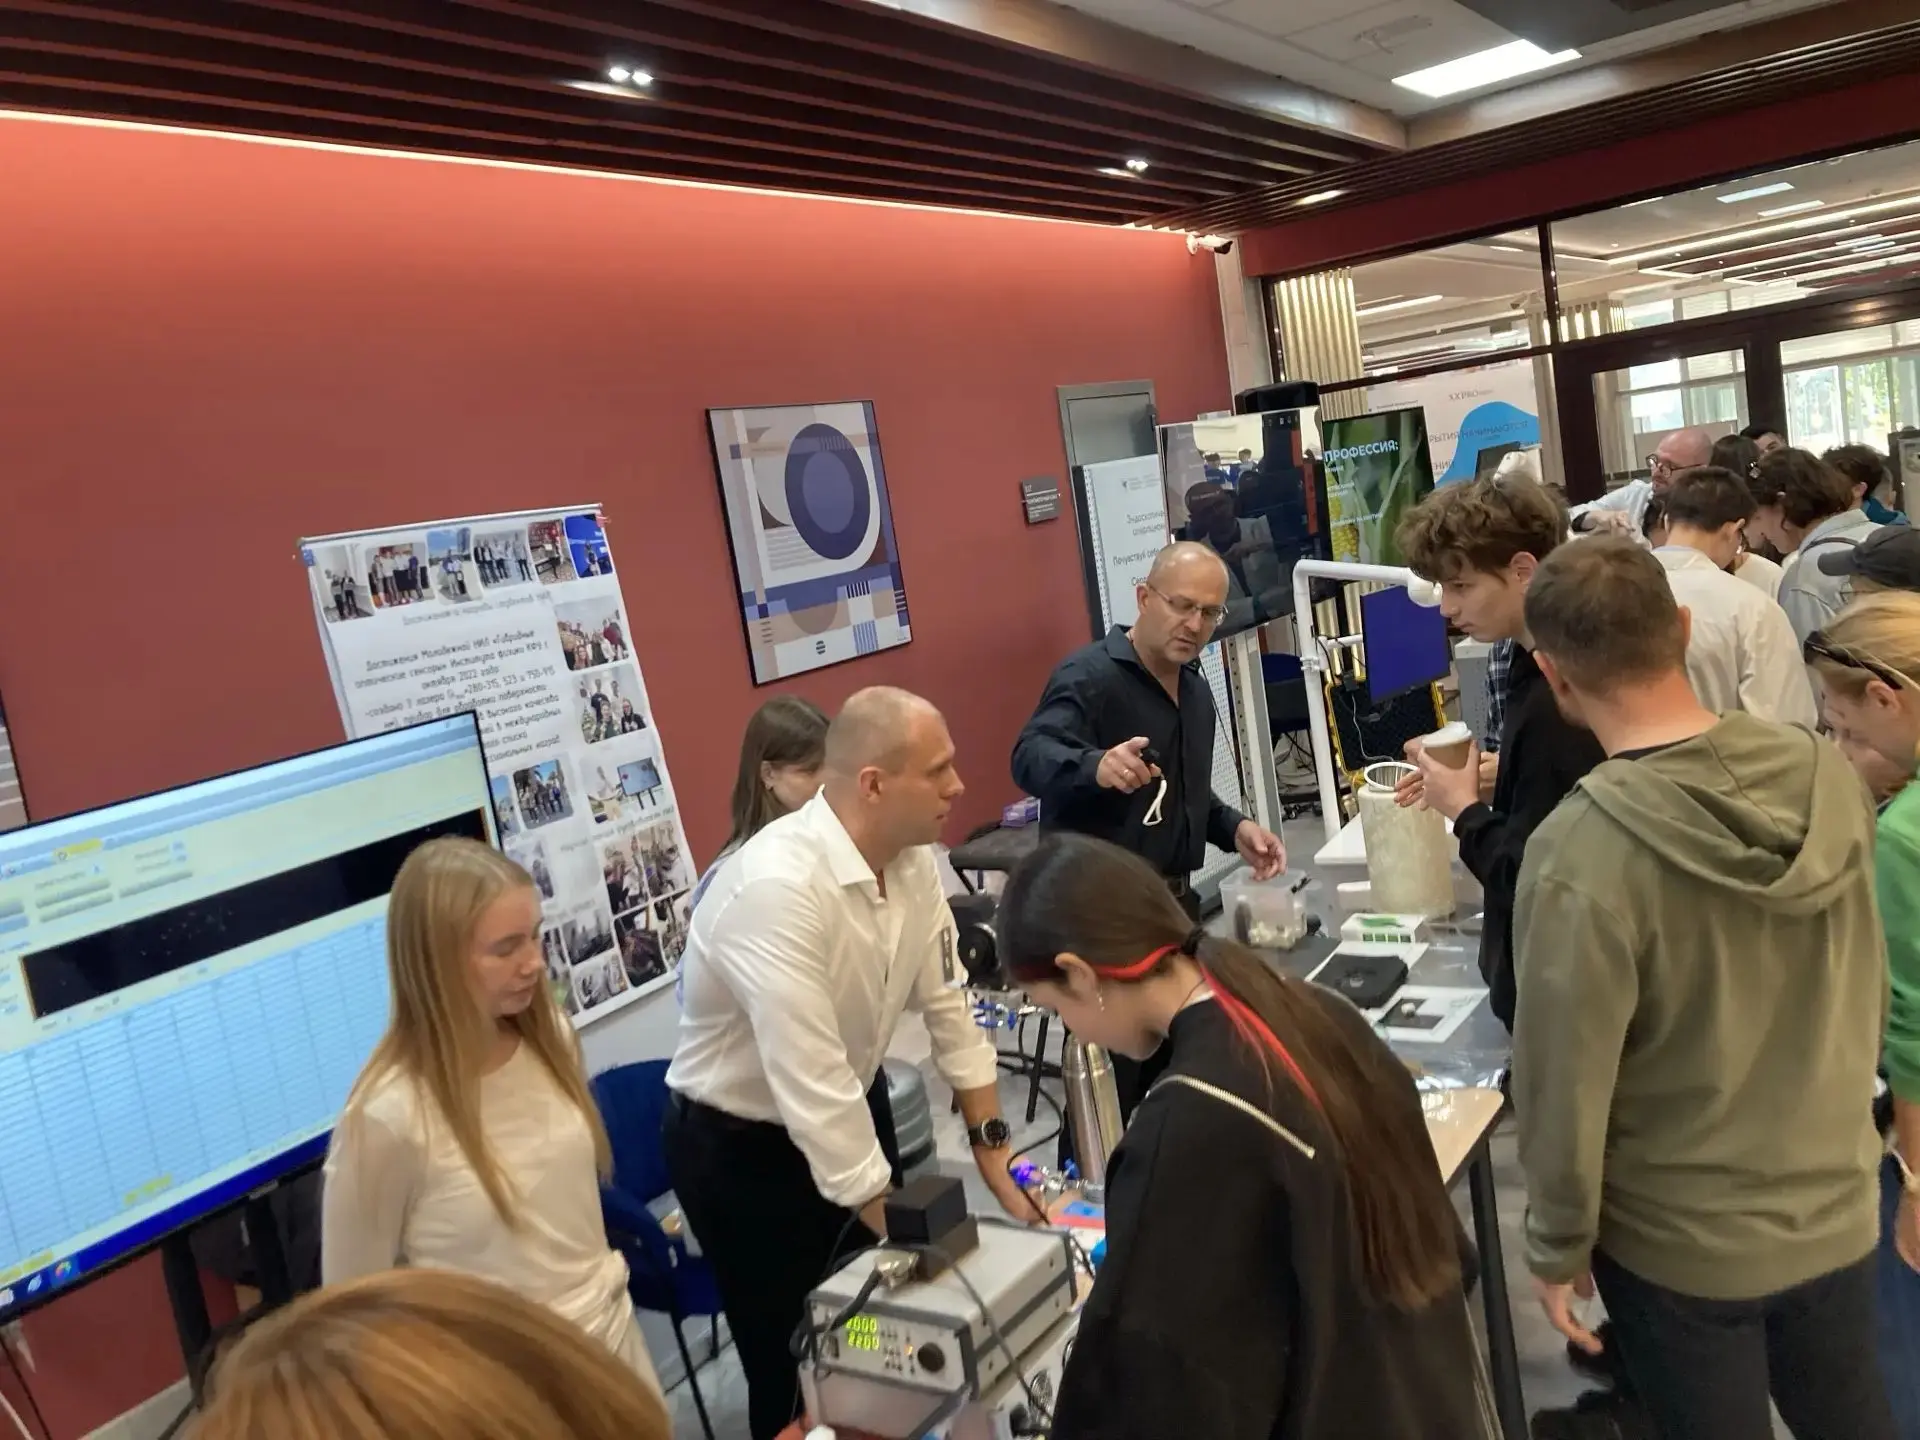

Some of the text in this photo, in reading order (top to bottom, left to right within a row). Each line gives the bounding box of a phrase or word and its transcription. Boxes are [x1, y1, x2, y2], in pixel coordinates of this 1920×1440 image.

[1324, 439, 1400, 463] ПРОФЕССИЯ:
[366, 653, 418, 671] Достижения
[459, 667, 478, 681] 2022
